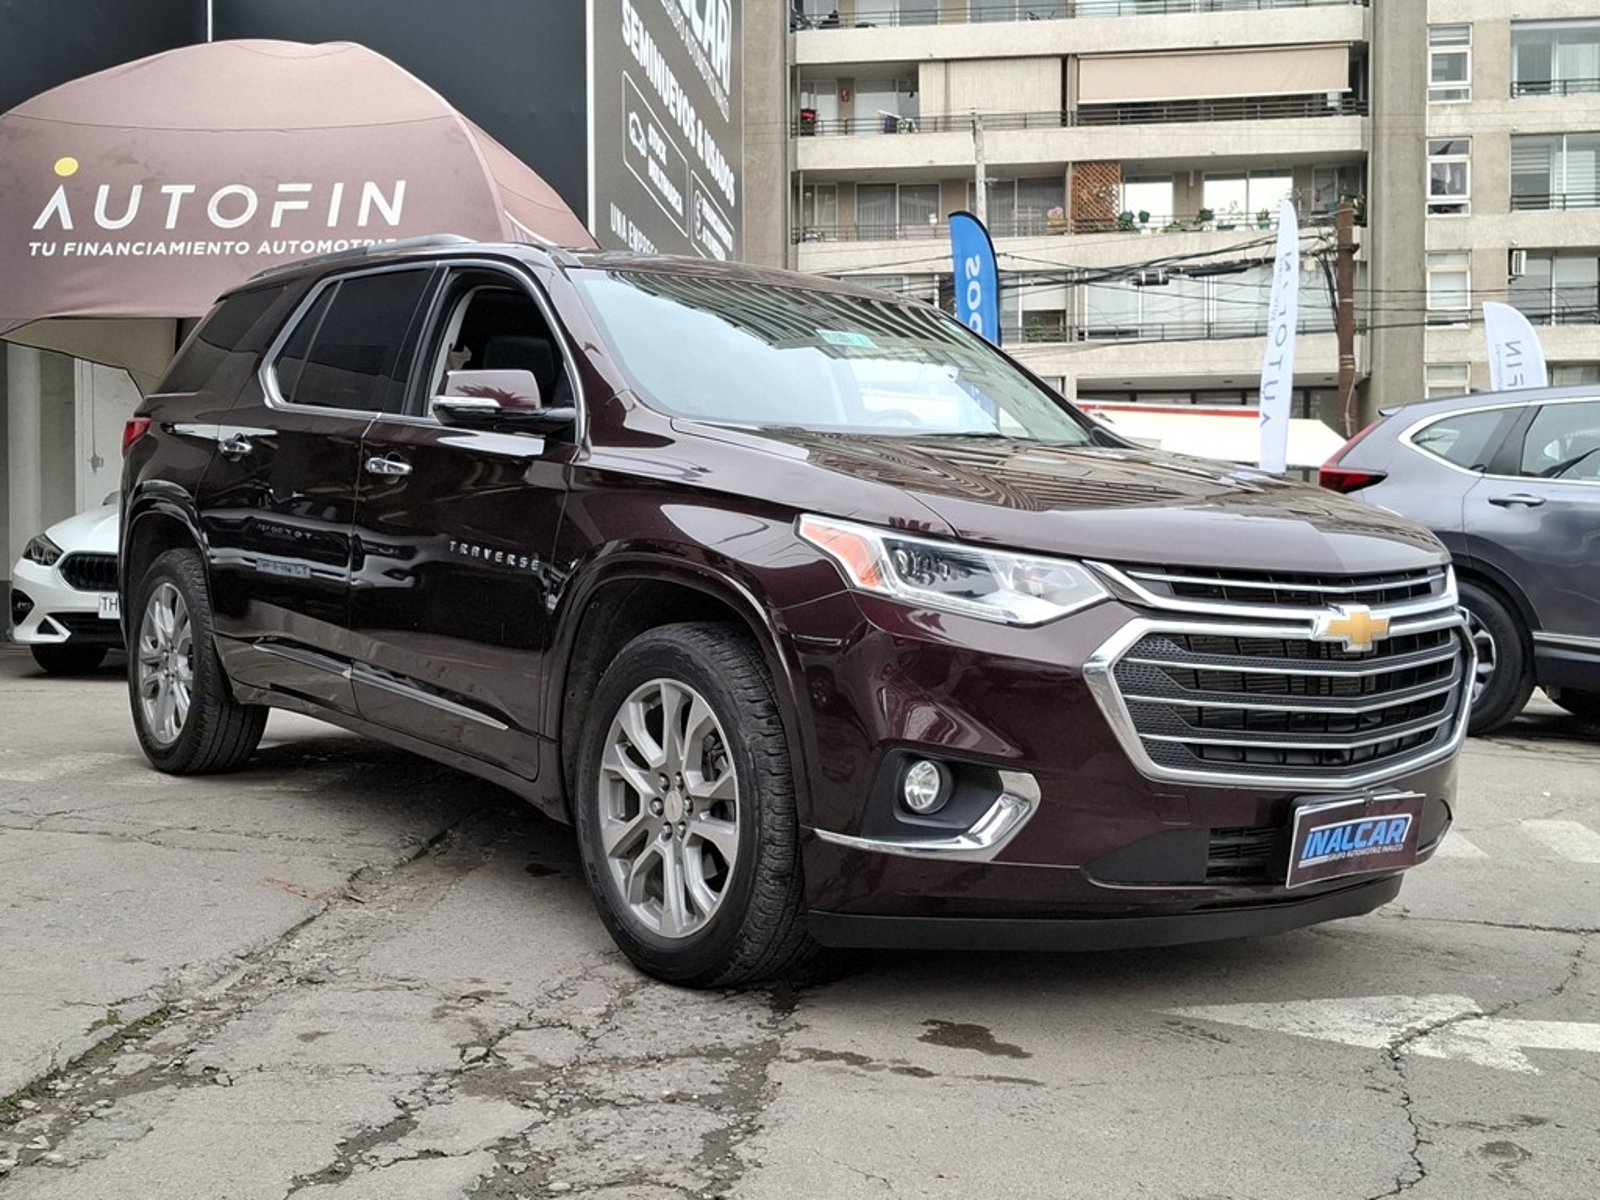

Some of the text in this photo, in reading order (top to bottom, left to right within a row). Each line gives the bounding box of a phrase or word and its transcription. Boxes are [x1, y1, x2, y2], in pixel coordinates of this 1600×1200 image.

[621, 0, 697, 147] SEMINUEVOS
[32, 179, 407, 230] AUTOFIN
[29, 239, 397, 257] TU FINANCIAMIENTO AUTOMOT
[449, 540, 540, 572] TRAVERSE
[1301, 818, 1407, 859] INALCAR
